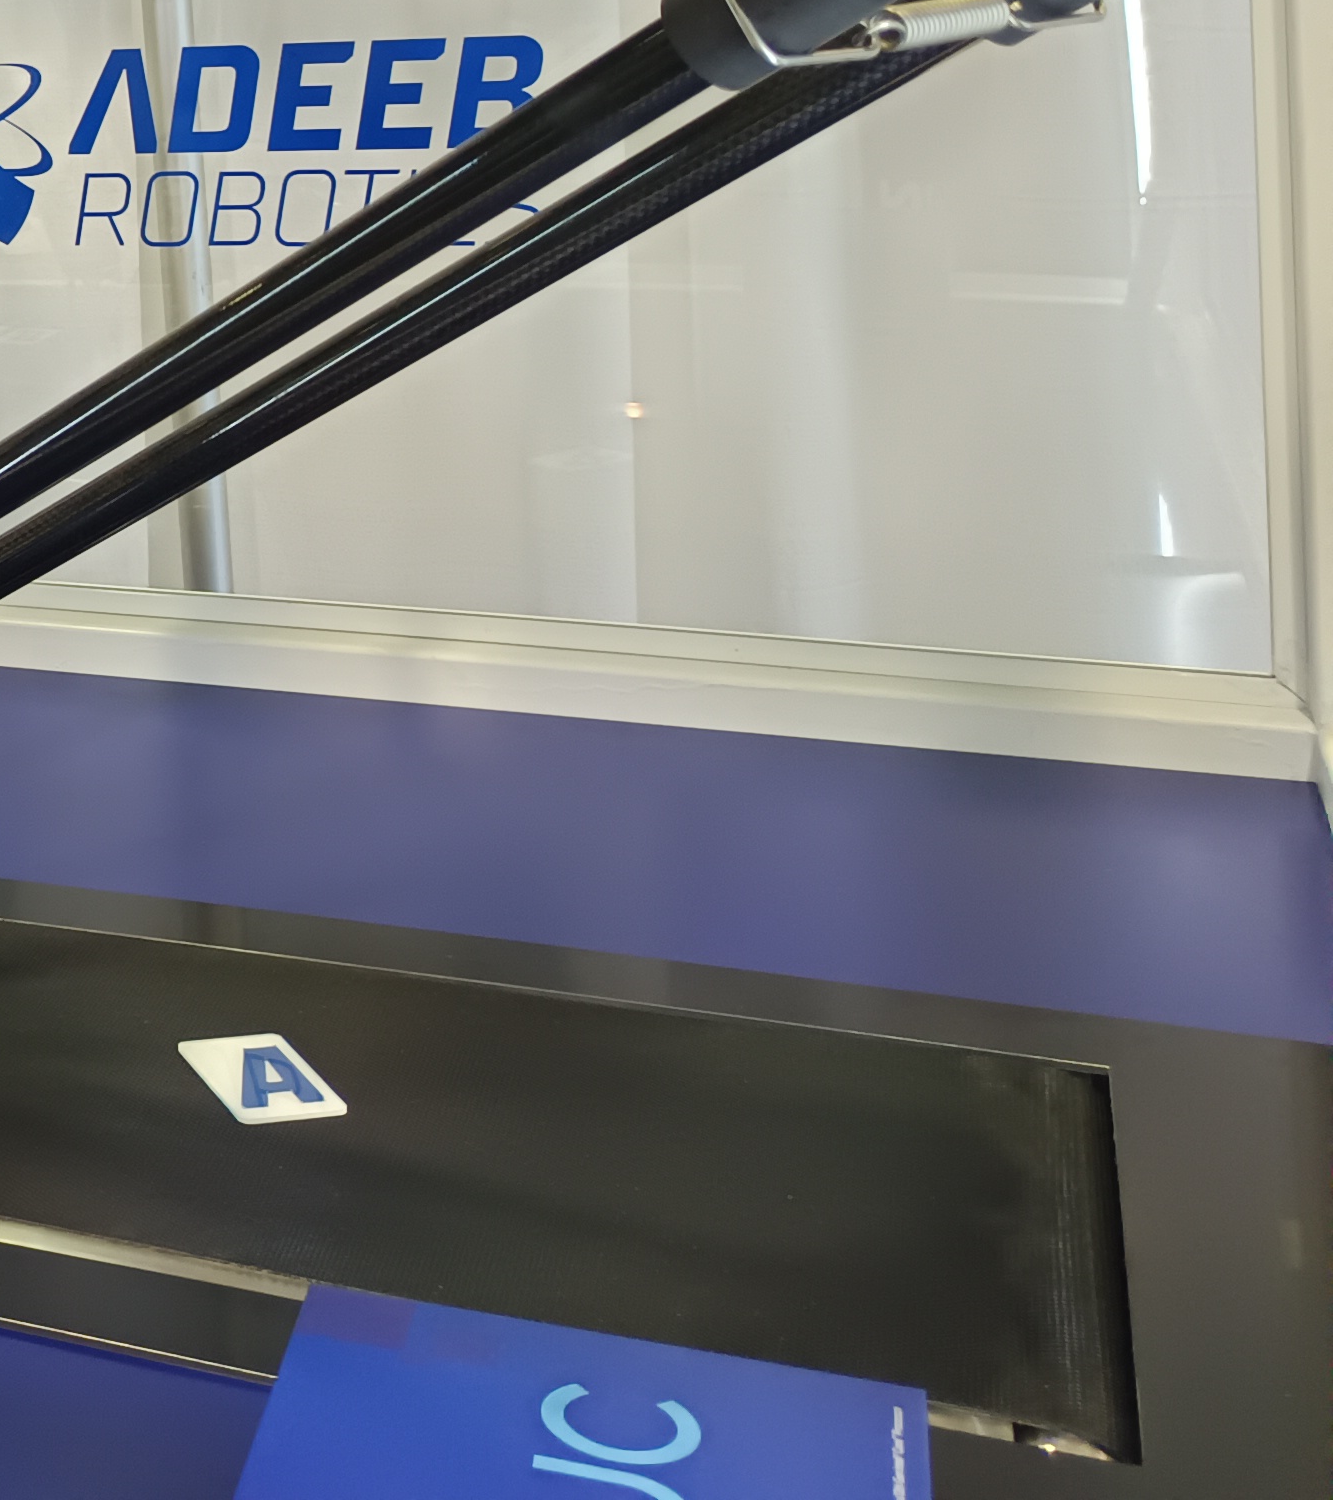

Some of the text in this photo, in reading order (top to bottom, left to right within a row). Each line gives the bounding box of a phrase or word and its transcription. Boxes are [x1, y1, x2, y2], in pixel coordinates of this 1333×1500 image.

[68, 35, 544, 155] ADEEB
[75, 169, 540, 247] ROBOT
[241, 1045, 325, 1109] A
